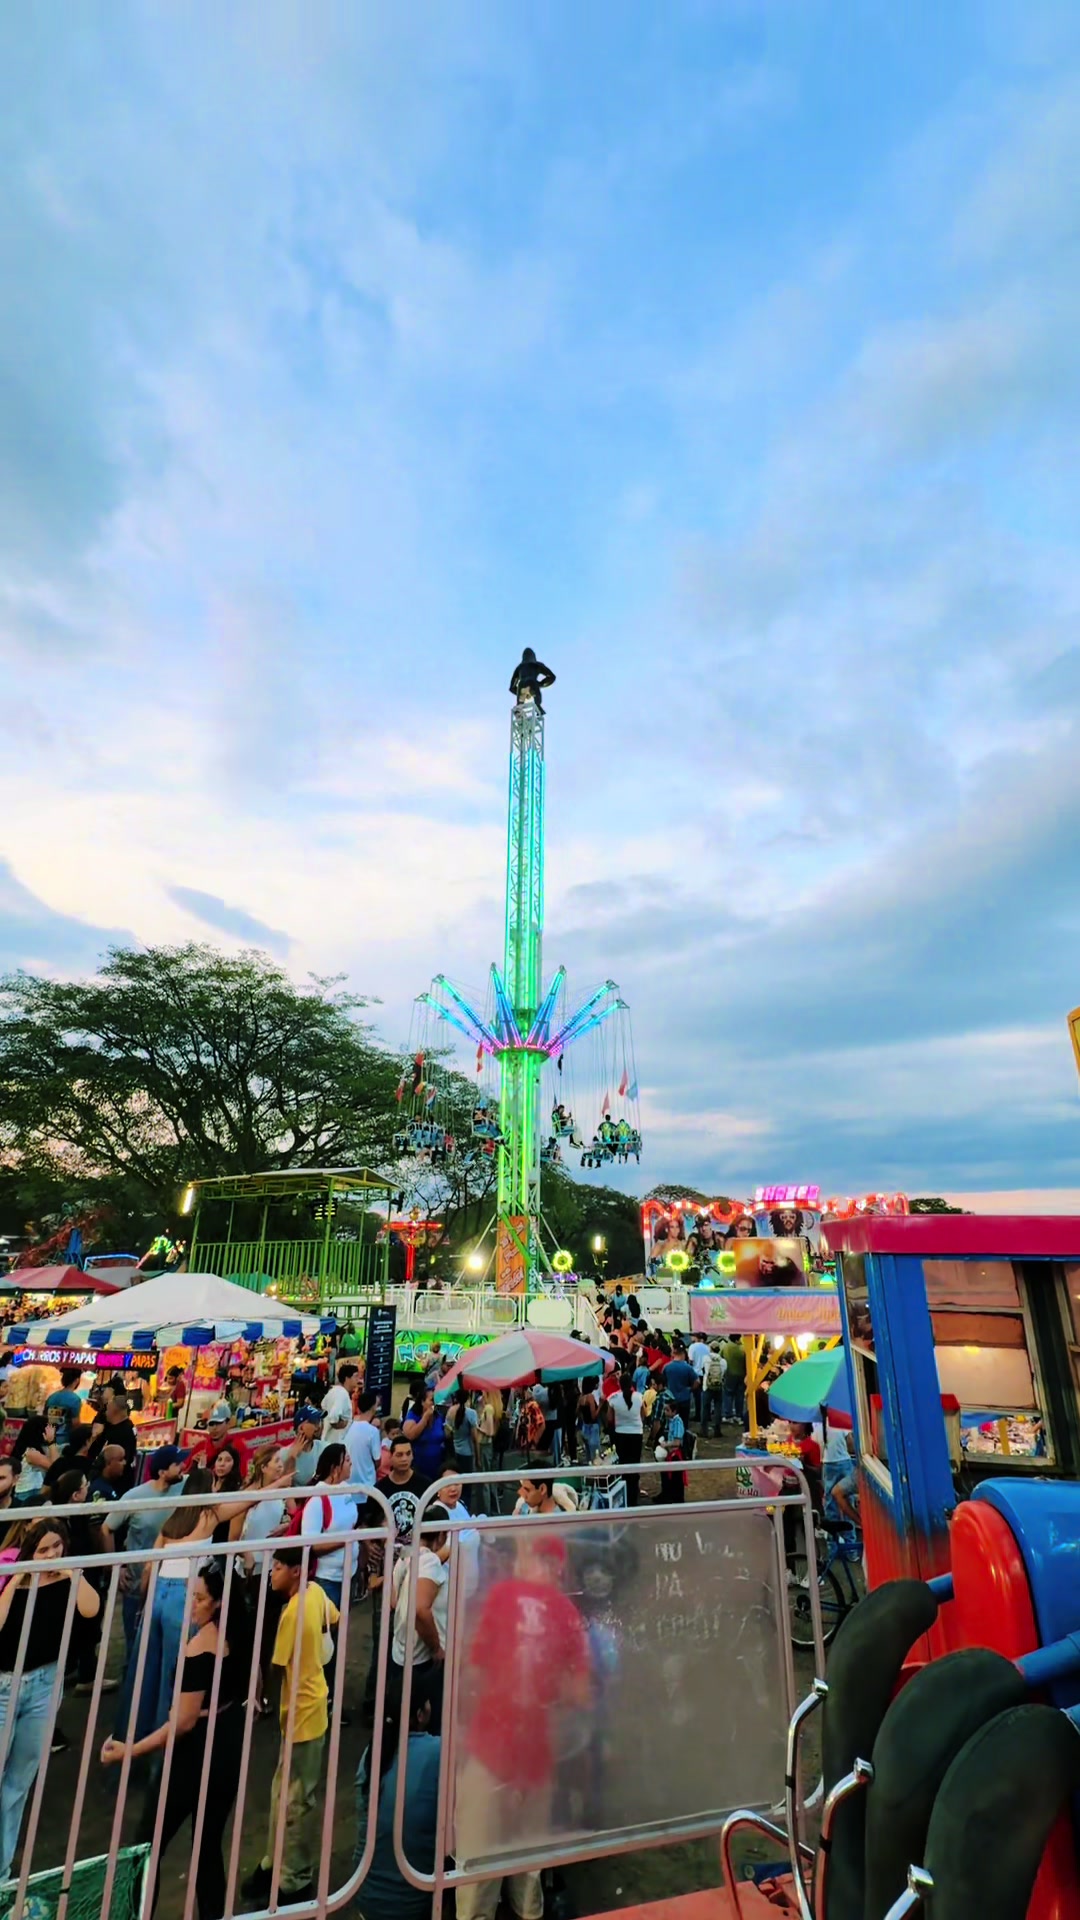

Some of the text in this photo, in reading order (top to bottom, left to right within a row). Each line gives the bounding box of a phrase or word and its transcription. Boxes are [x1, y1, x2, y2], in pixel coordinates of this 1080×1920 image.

[62, 1351, 68, 1362] Y
[69, 1352, 97, 1365] PAPAS
[131, 1355, 156, 1368] PAPAS
